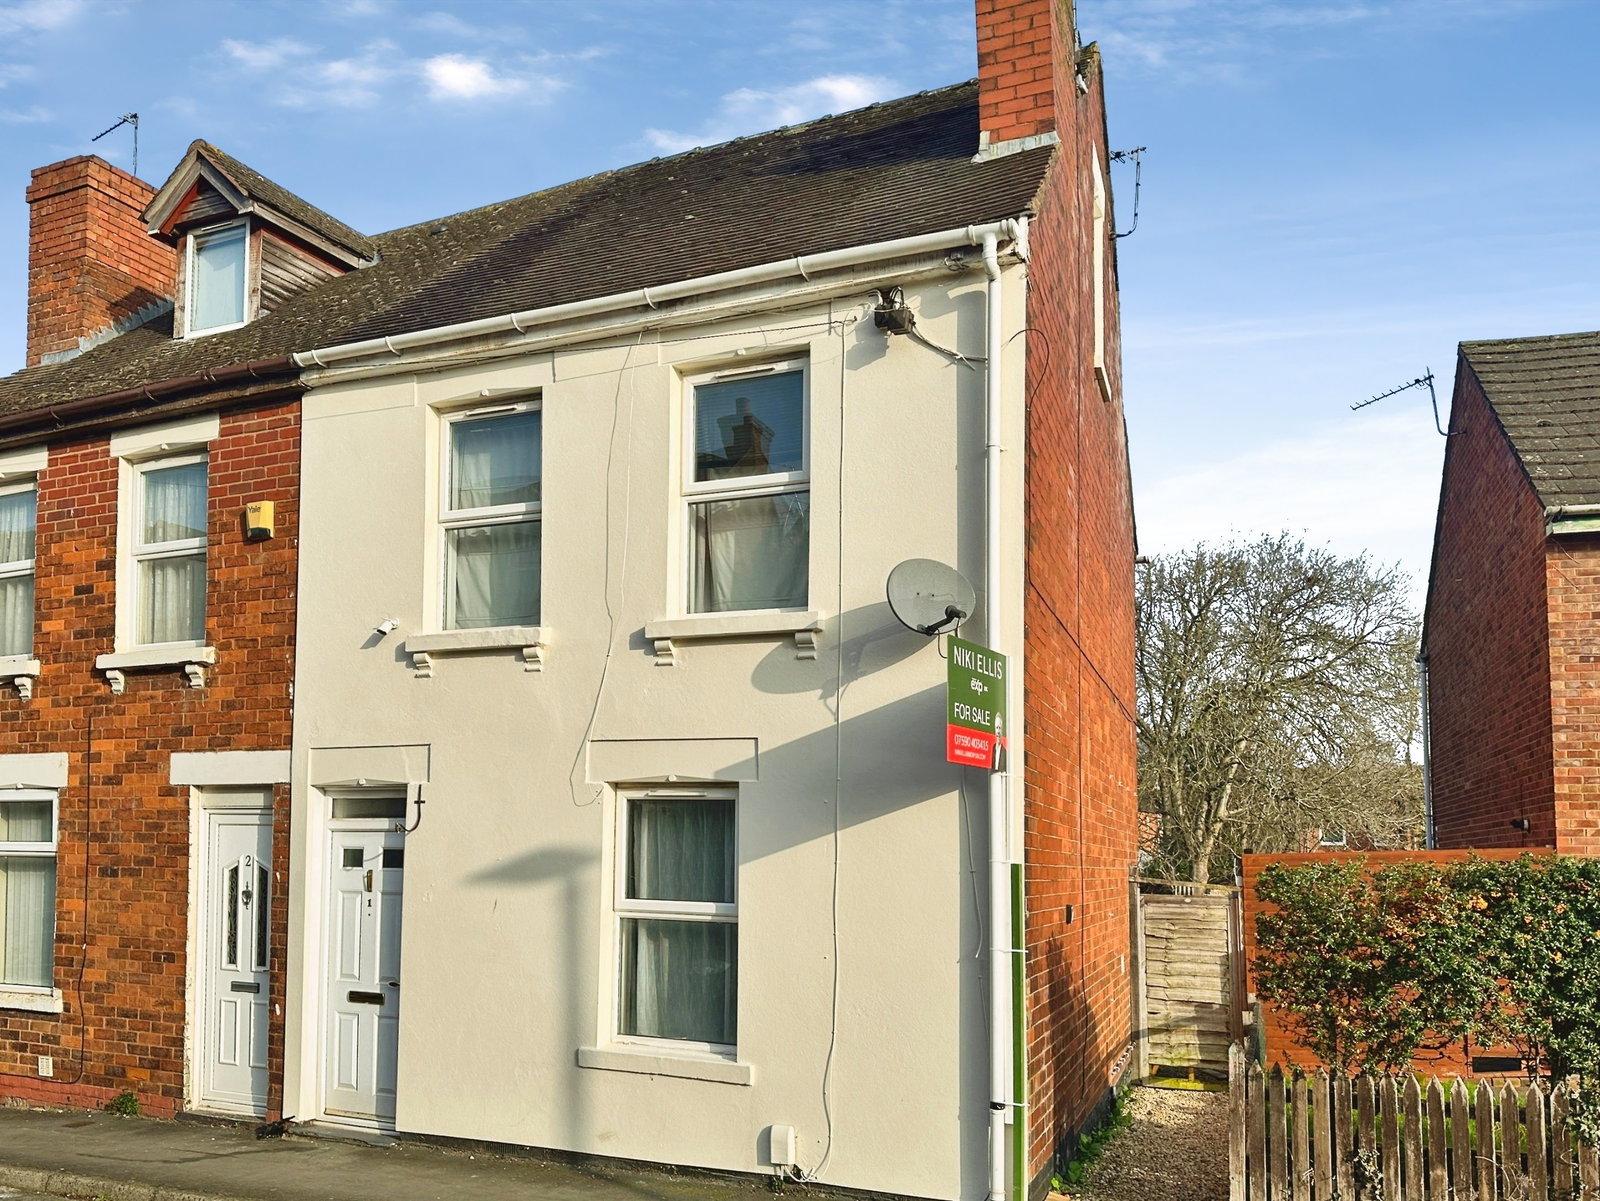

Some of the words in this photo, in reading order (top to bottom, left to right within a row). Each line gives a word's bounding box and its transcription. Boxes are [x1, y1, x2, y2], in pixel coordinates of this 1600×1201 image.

[953, 645, 975, 670] NIKI
[977, 653, 1002, 680] ELLIS
[954, 702, 971, 721] FOR
[972, 706, 991, 726] SALE
[245, 854, 251, 867] 2
[367, 898, 372, 908] 1
